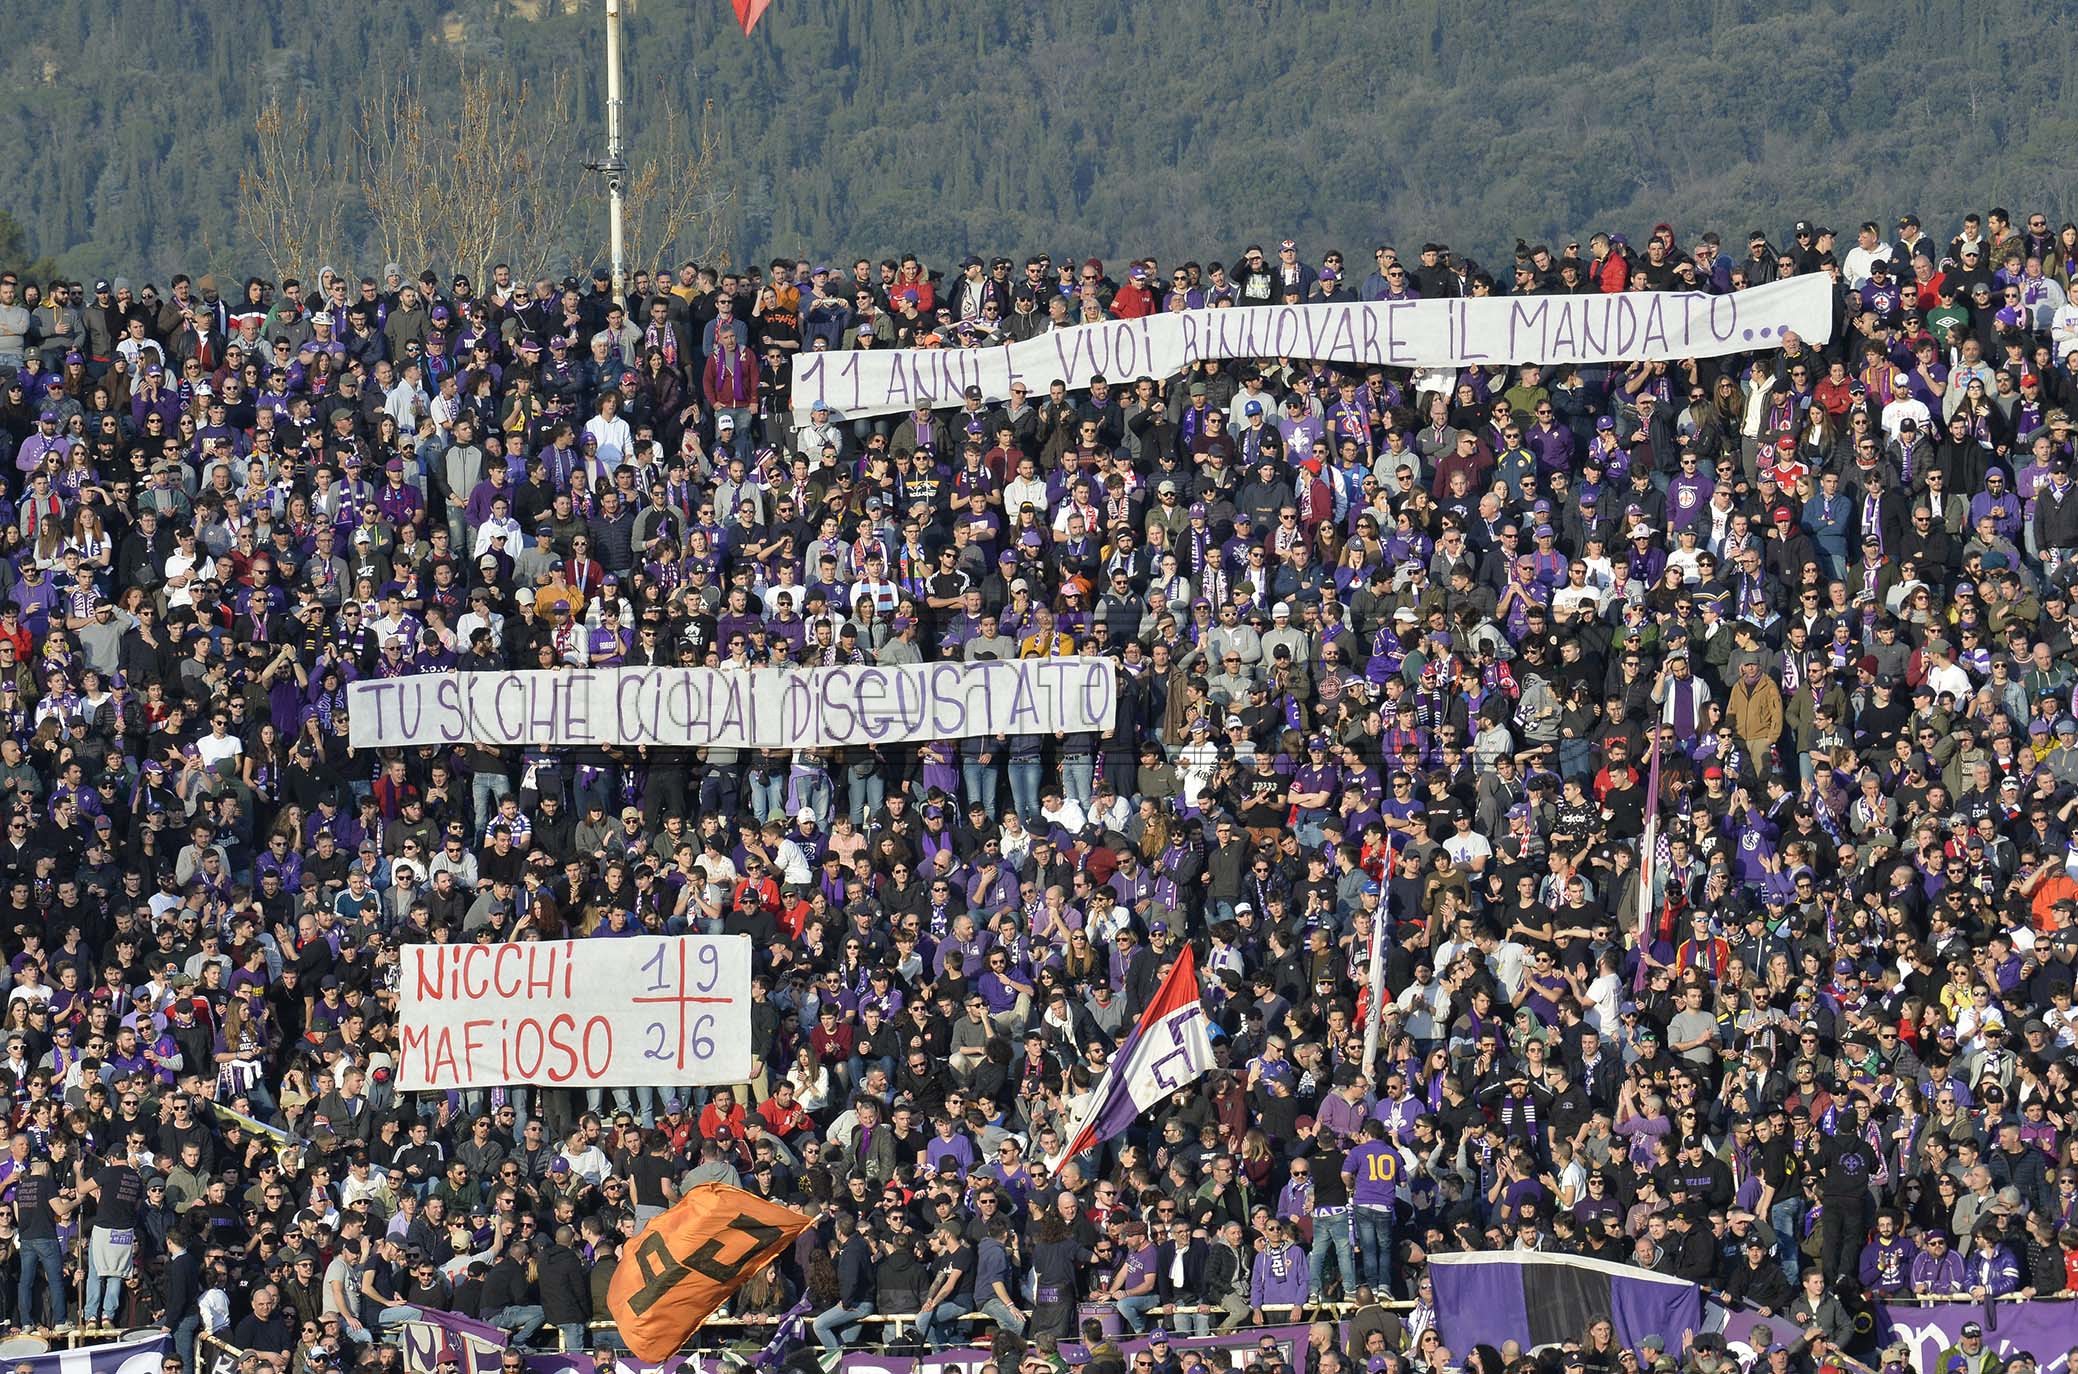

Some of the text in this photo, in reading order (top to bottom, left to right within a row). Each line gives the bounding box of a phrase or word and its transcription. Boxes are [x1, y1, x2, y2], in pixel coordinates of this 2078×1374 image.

[801, 351, 869, 412] 11
[357, 683, 421, 741] TU
[495, 674, 596, 741] CHE
[1367, 1154, 1396, 1181] 10
